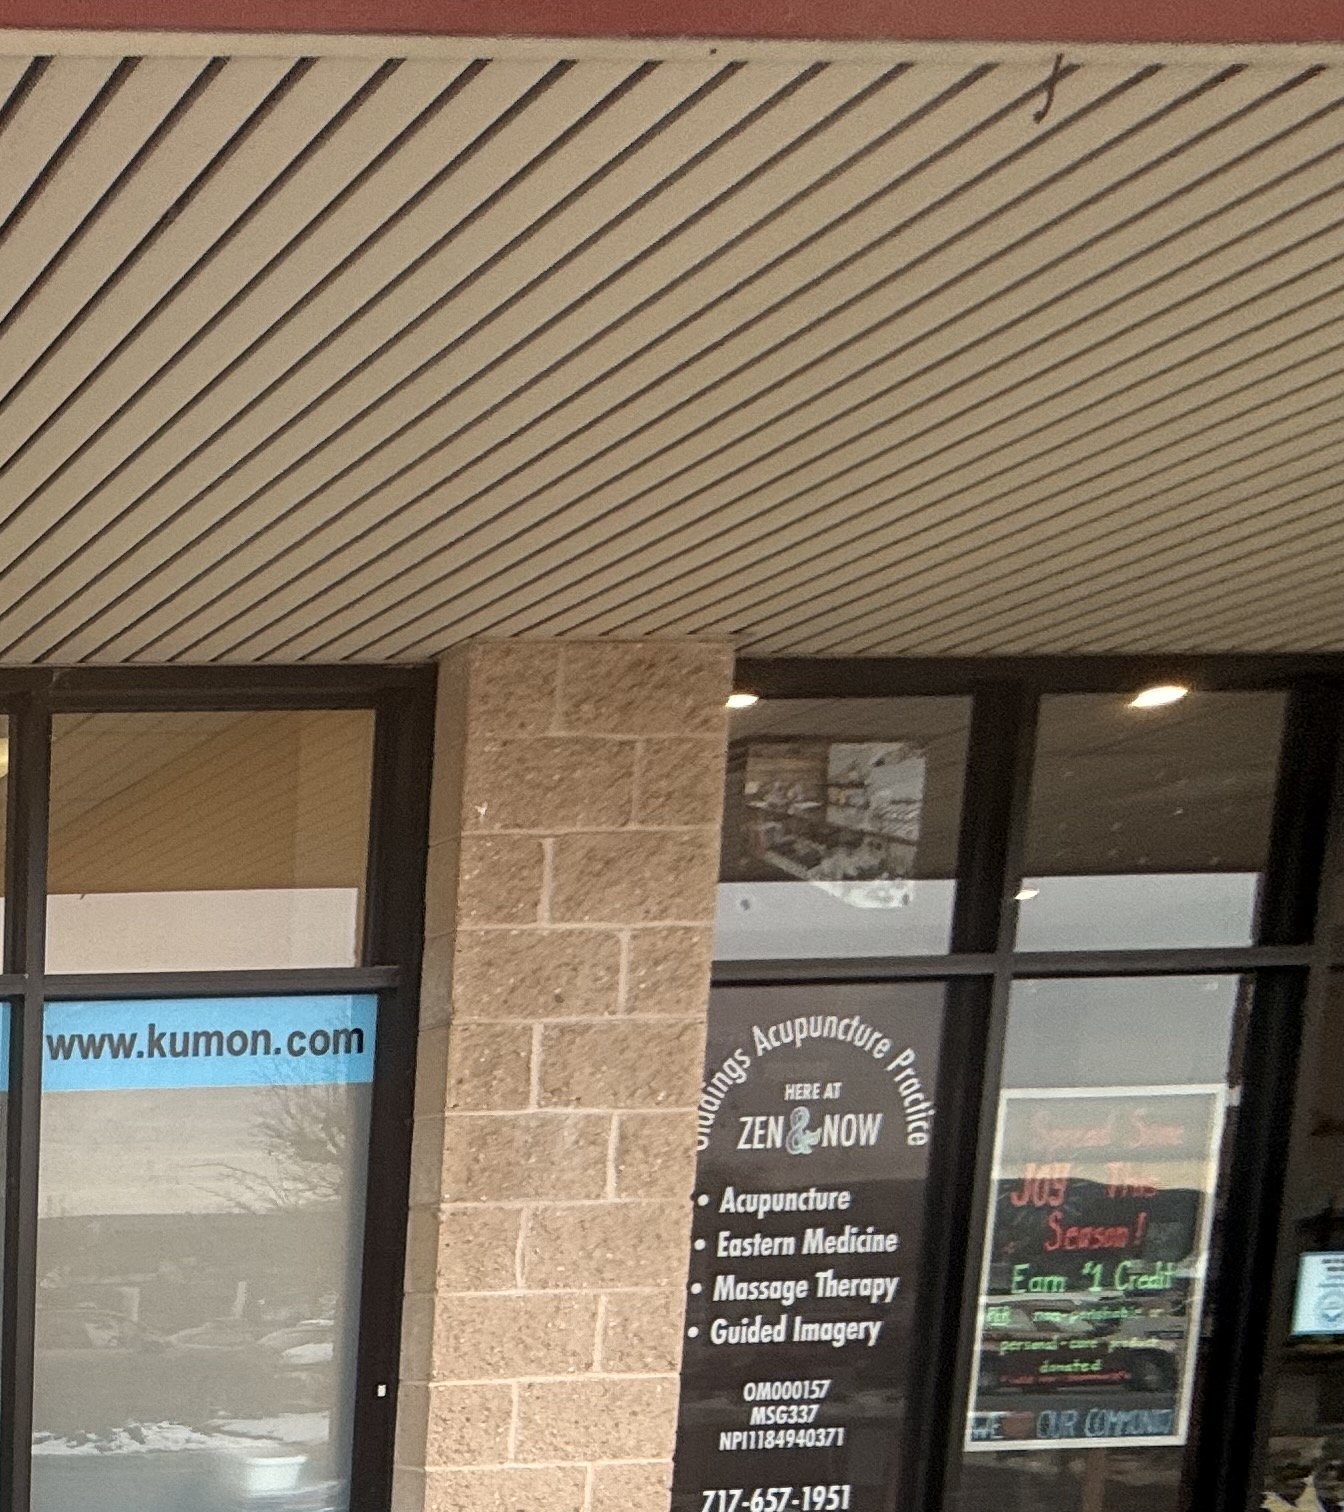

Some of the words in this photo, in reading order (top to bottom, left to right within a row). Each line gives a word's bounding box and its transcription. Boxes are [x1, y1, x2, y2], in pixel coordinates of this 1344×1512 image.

[47, 1023, 364, 1060] www.kumon.com
[752, 1015, 893, 1060] Acupuncture
[884, 1048, 937, 1146] Practice
[784, 1083, 821, 1100] HERE
[823, 1082, 843, 1099] AT
[737, 1115, 785, 1150] ZEN
[821, 1114, 883, 1147] NOW
[719, 1186, 851, 1219] Acupuncture
[717, 1231, 796, 1257] Eastern
[801, 1225, 900, 1255] Medicine
[712, 1274, 808, 1306] Massage
[815, 1269, 900, 1303] Therapy
[1010, 1263, 1069, 1294] Earn
[1115, 1260, 1178, 1291] Credit
[710, 1314, 788, 1345] Guided
[792, 1316, 883, 1347] Imagery
[743, 1379, 832, 1401] OM000157
[750, 1404, 820, 1425] MSG337
[718, 1427, 845, 1451] NPI1184940371
